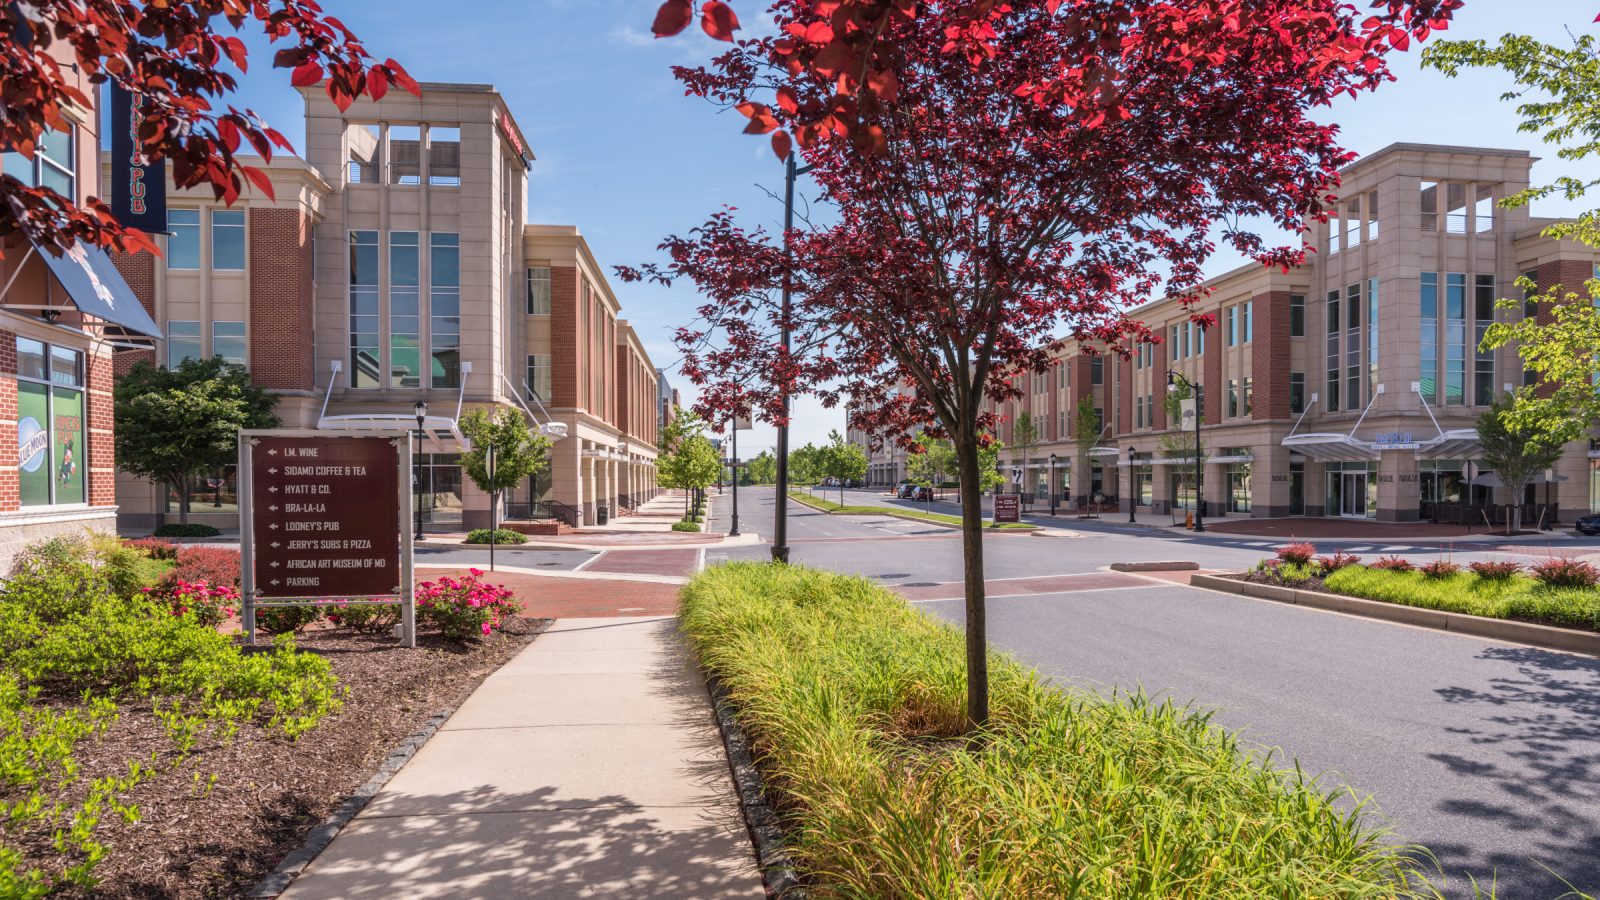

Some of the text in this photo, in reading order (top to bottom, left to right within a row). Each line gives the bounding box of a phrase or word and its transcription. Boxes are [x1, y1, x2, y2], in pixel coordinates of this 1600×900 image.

[130, 167, 147, 214] PUB
[18, 445, 30, 464] LUE
[299, 447, 319, 457] WINE
[284, 466, 367, 476] SIDAMO COFFEE & TEA
[285, 484, 332, 494] HYATT & CO.
[285, 503, 326, 513] BRA-LA-LA
[285, 521, 340, 531] LOONEY'S PUB
[287, 539, 371, 550] JERRY'S SUBS & PIZZA
[286, 559, 317, 569] AFRICAN
[317, 559, 332, 569] ART
[332, 559, 362, 569] MUSEUM
[363, 559, 373, 568] OF
[286, 577, 320, 587] PARKING
